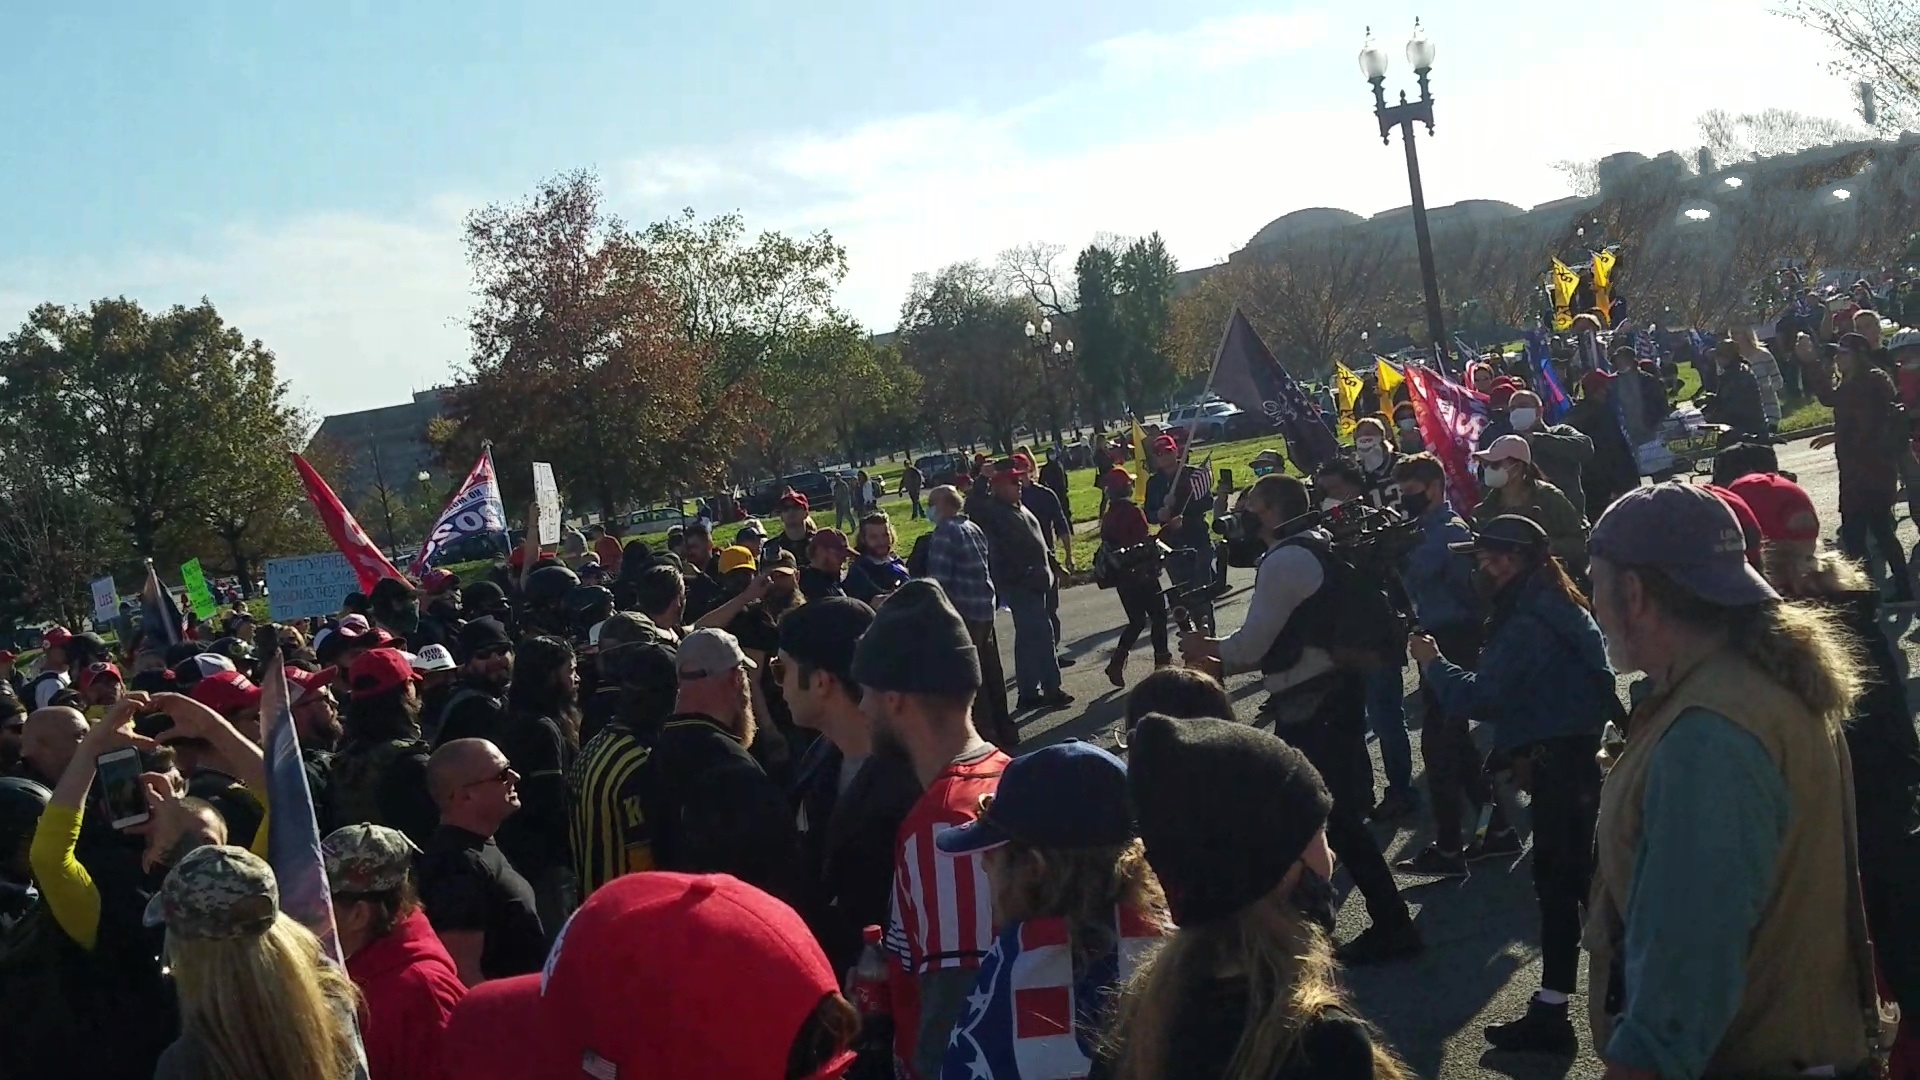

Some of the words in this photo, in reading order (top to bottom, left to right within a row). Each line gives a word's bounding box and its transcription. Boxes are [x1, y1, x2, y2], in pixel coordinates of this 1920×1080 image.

[1369, 483, 1409, 522] 12
[279, 574, 306, 588] WITH
[307, 572, 326, 585] THE
[277, 605, 293, 617] TO
